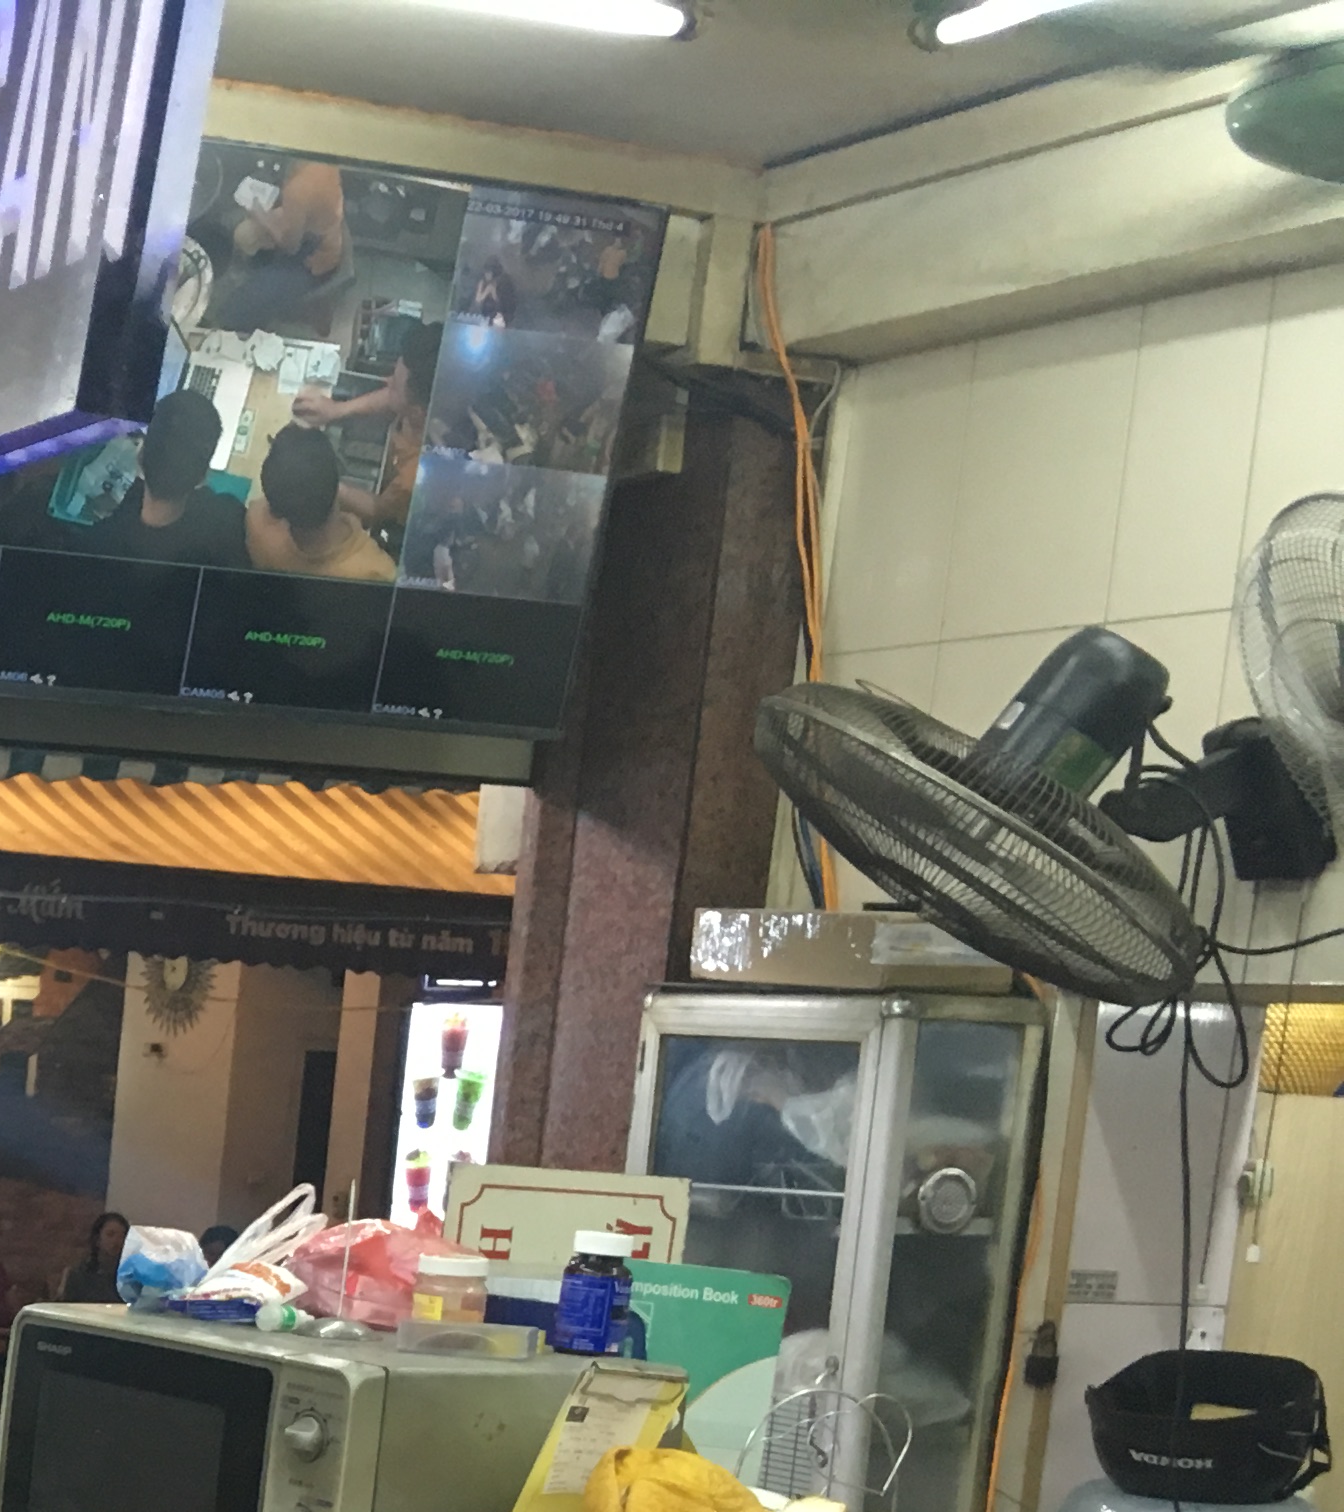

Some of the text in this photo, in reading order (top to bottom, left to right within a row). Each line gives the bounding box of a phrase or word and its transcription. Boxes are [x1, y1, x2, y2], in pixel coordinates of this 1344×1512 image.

[225, 910, 327, 946] Thương
[331, 921, 382, 951] hiệu
[421, 929, 474, 955] năm
[630, 1281, 740, 1305] mposition Book
[1127, 1448, 1214, 1470] HONDA
